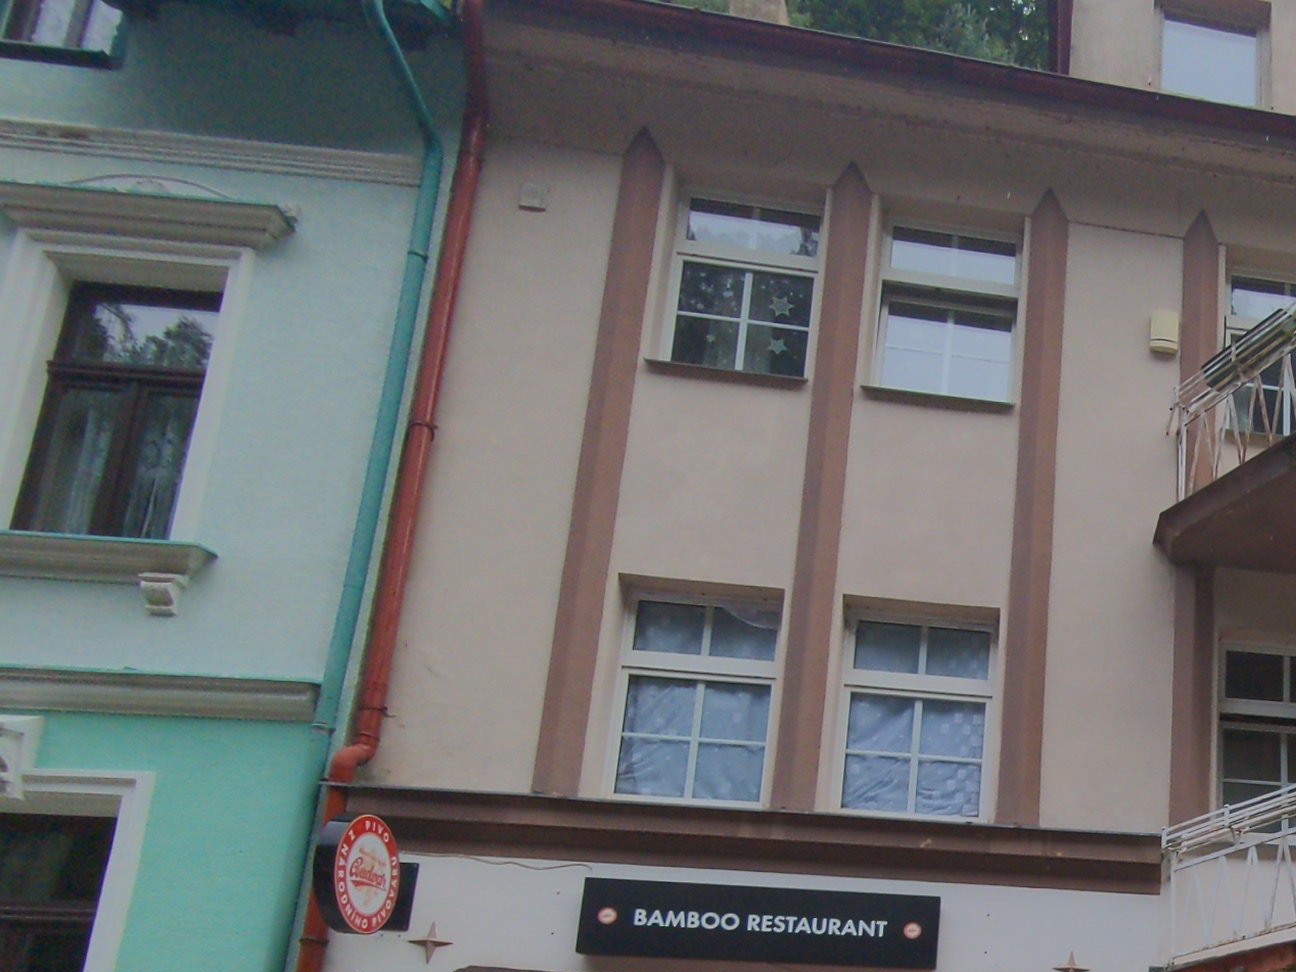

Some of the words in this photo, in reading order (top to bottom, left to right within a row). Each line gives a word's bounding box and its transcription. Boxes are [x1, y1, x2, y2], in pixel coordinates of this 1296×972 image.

[365, 820, 390, 842] PIVO
[633, 908, 741, 931] BAMBOO
[746, 914, 888, 937] RESTAURANT
